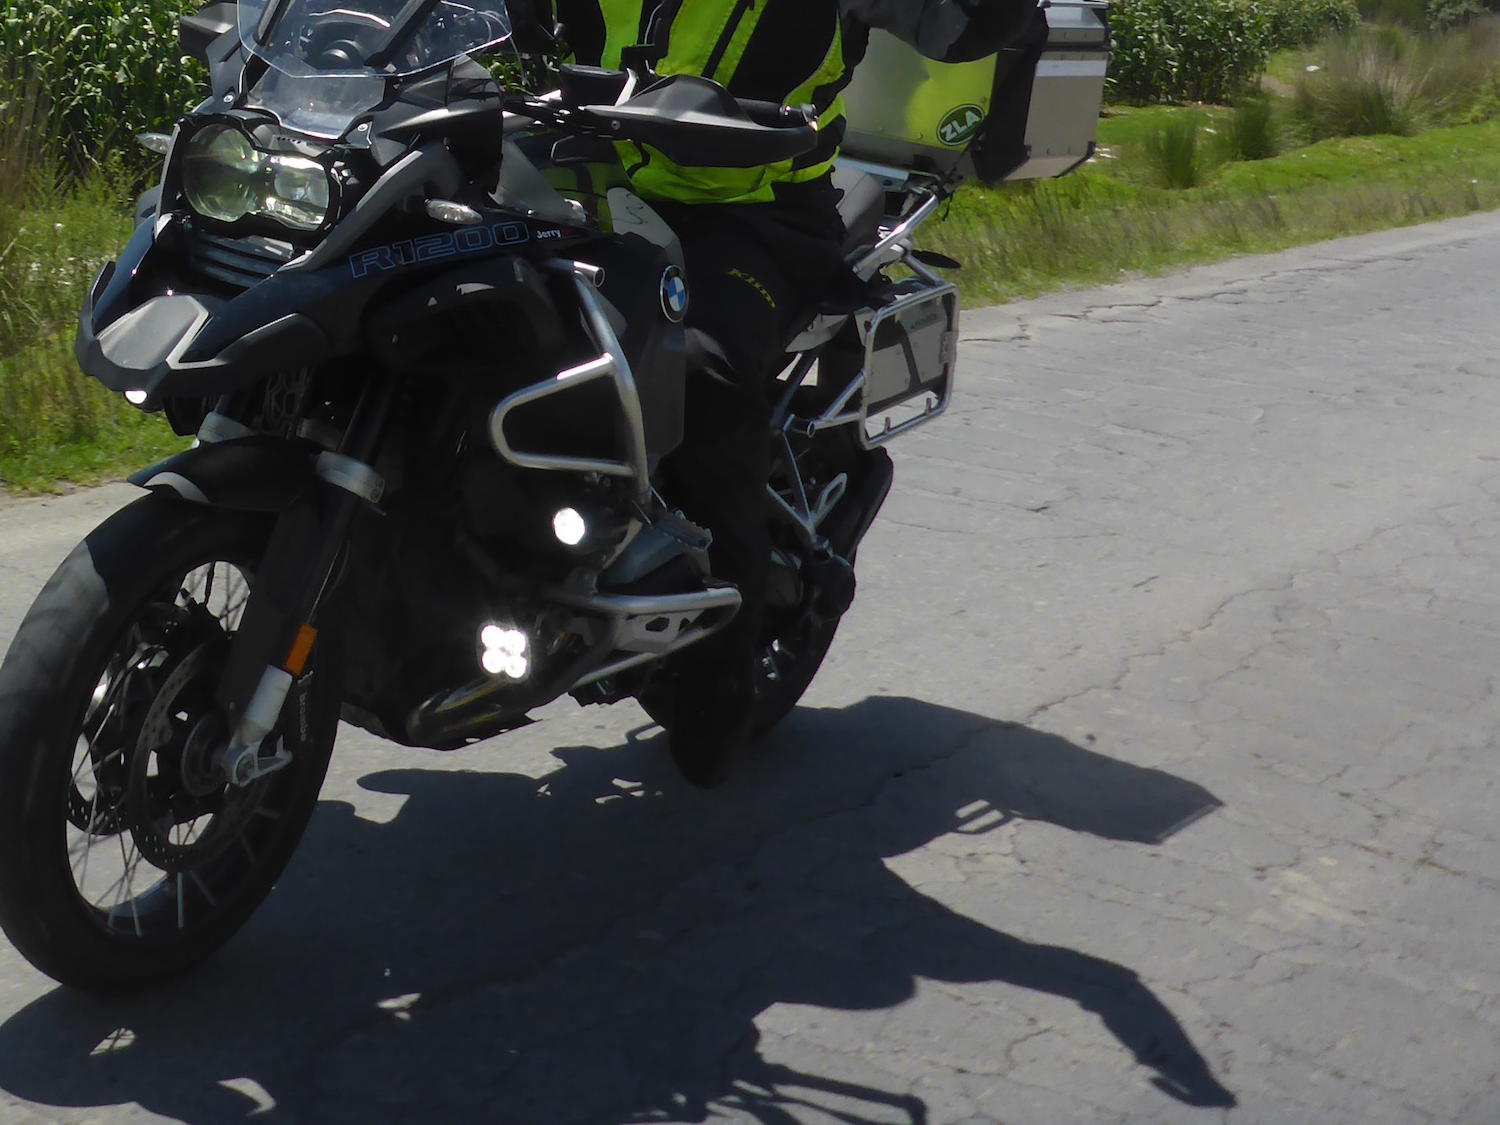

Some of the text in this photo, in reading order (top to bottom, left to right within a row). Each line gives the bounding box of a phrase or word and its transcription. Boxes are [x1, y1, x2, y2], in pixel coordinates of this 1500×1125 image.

[940, 110, 981, 141] ZLA
[349, 220, 529, 278] R1200
[536, 229, 562, 239] Jerry
